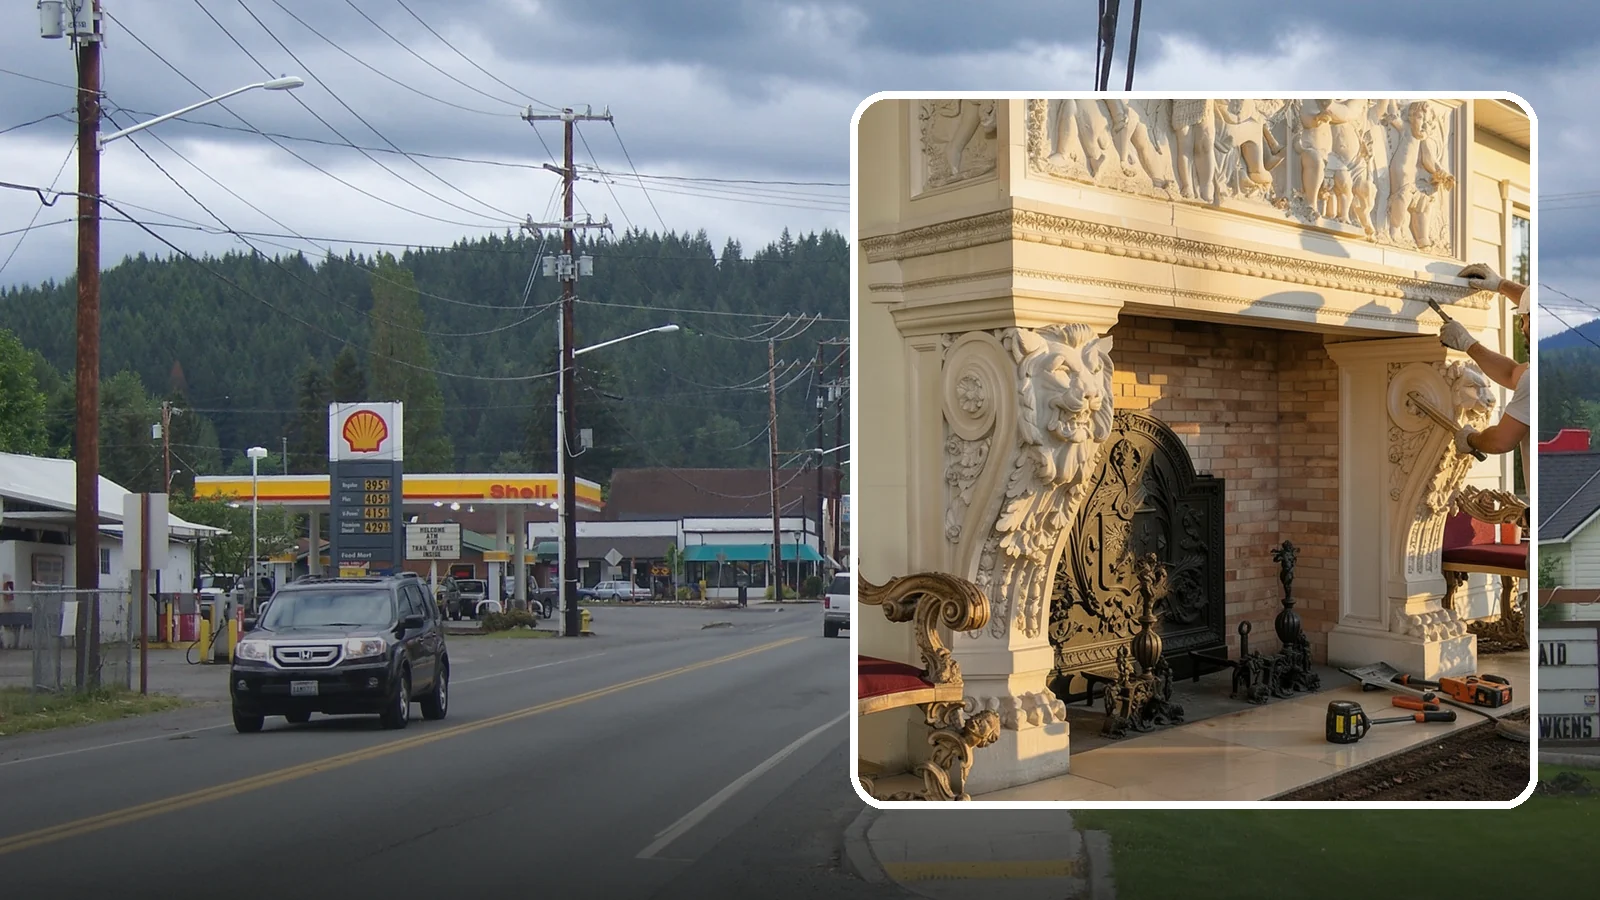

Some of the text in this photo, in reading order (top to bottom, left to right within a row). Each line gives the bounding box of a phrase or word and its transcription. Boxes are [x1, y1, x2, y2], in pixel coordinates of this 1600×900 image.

[365, 480, 383, 490] 395
[490, 484, 547, 499] Shell
[365, 494, 384, 504] 405
[365, 508, 384, 518] 415
[365, 522, 384, 533] 429
[1538, 642, 1567, 665] AID
[1538, 716, 1592, 739] WKENS
